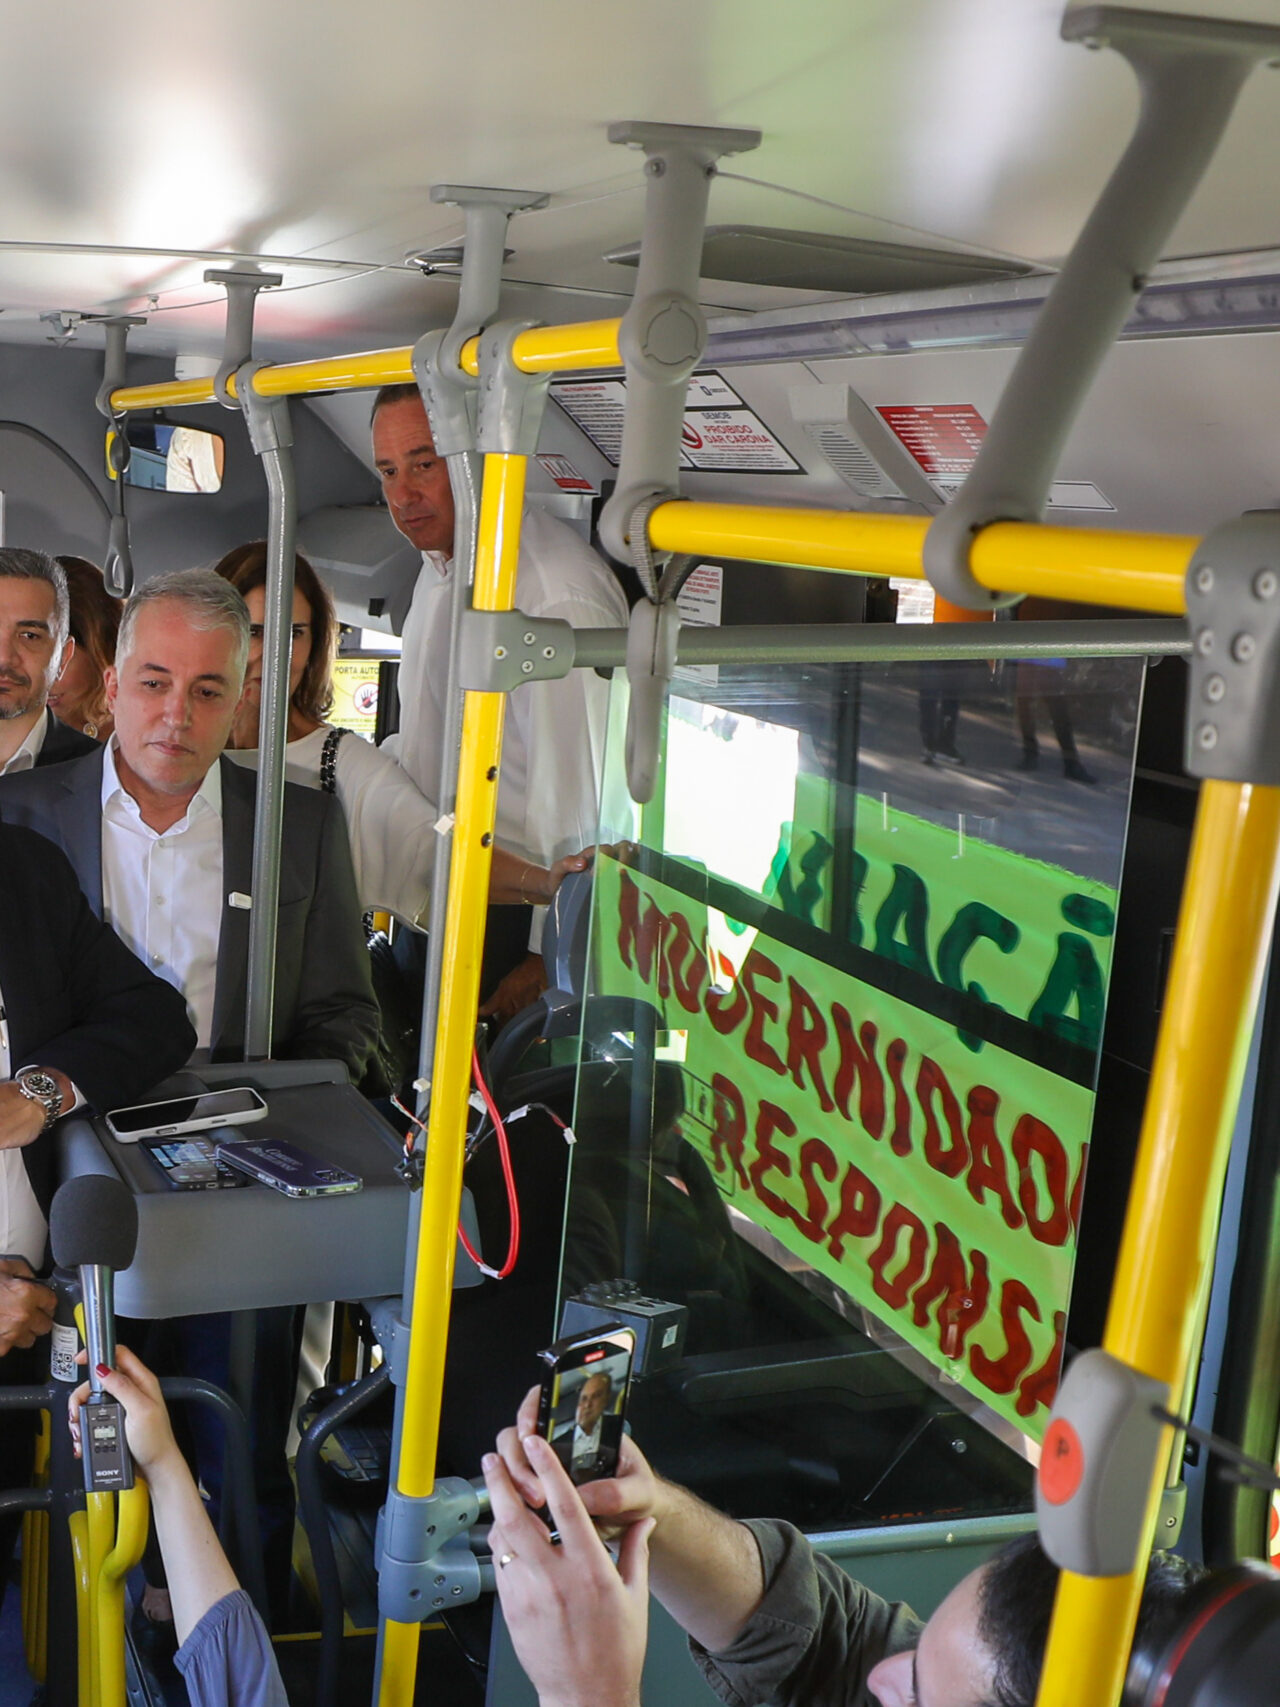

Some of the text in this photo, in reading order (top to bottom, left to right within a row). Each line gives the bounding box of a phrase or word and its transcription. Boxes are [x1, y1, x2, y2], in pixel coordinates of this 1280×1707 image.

[703, 424, 753, 434] PROIBIDO
[703, 434, 772, 444] DAR CARONA
